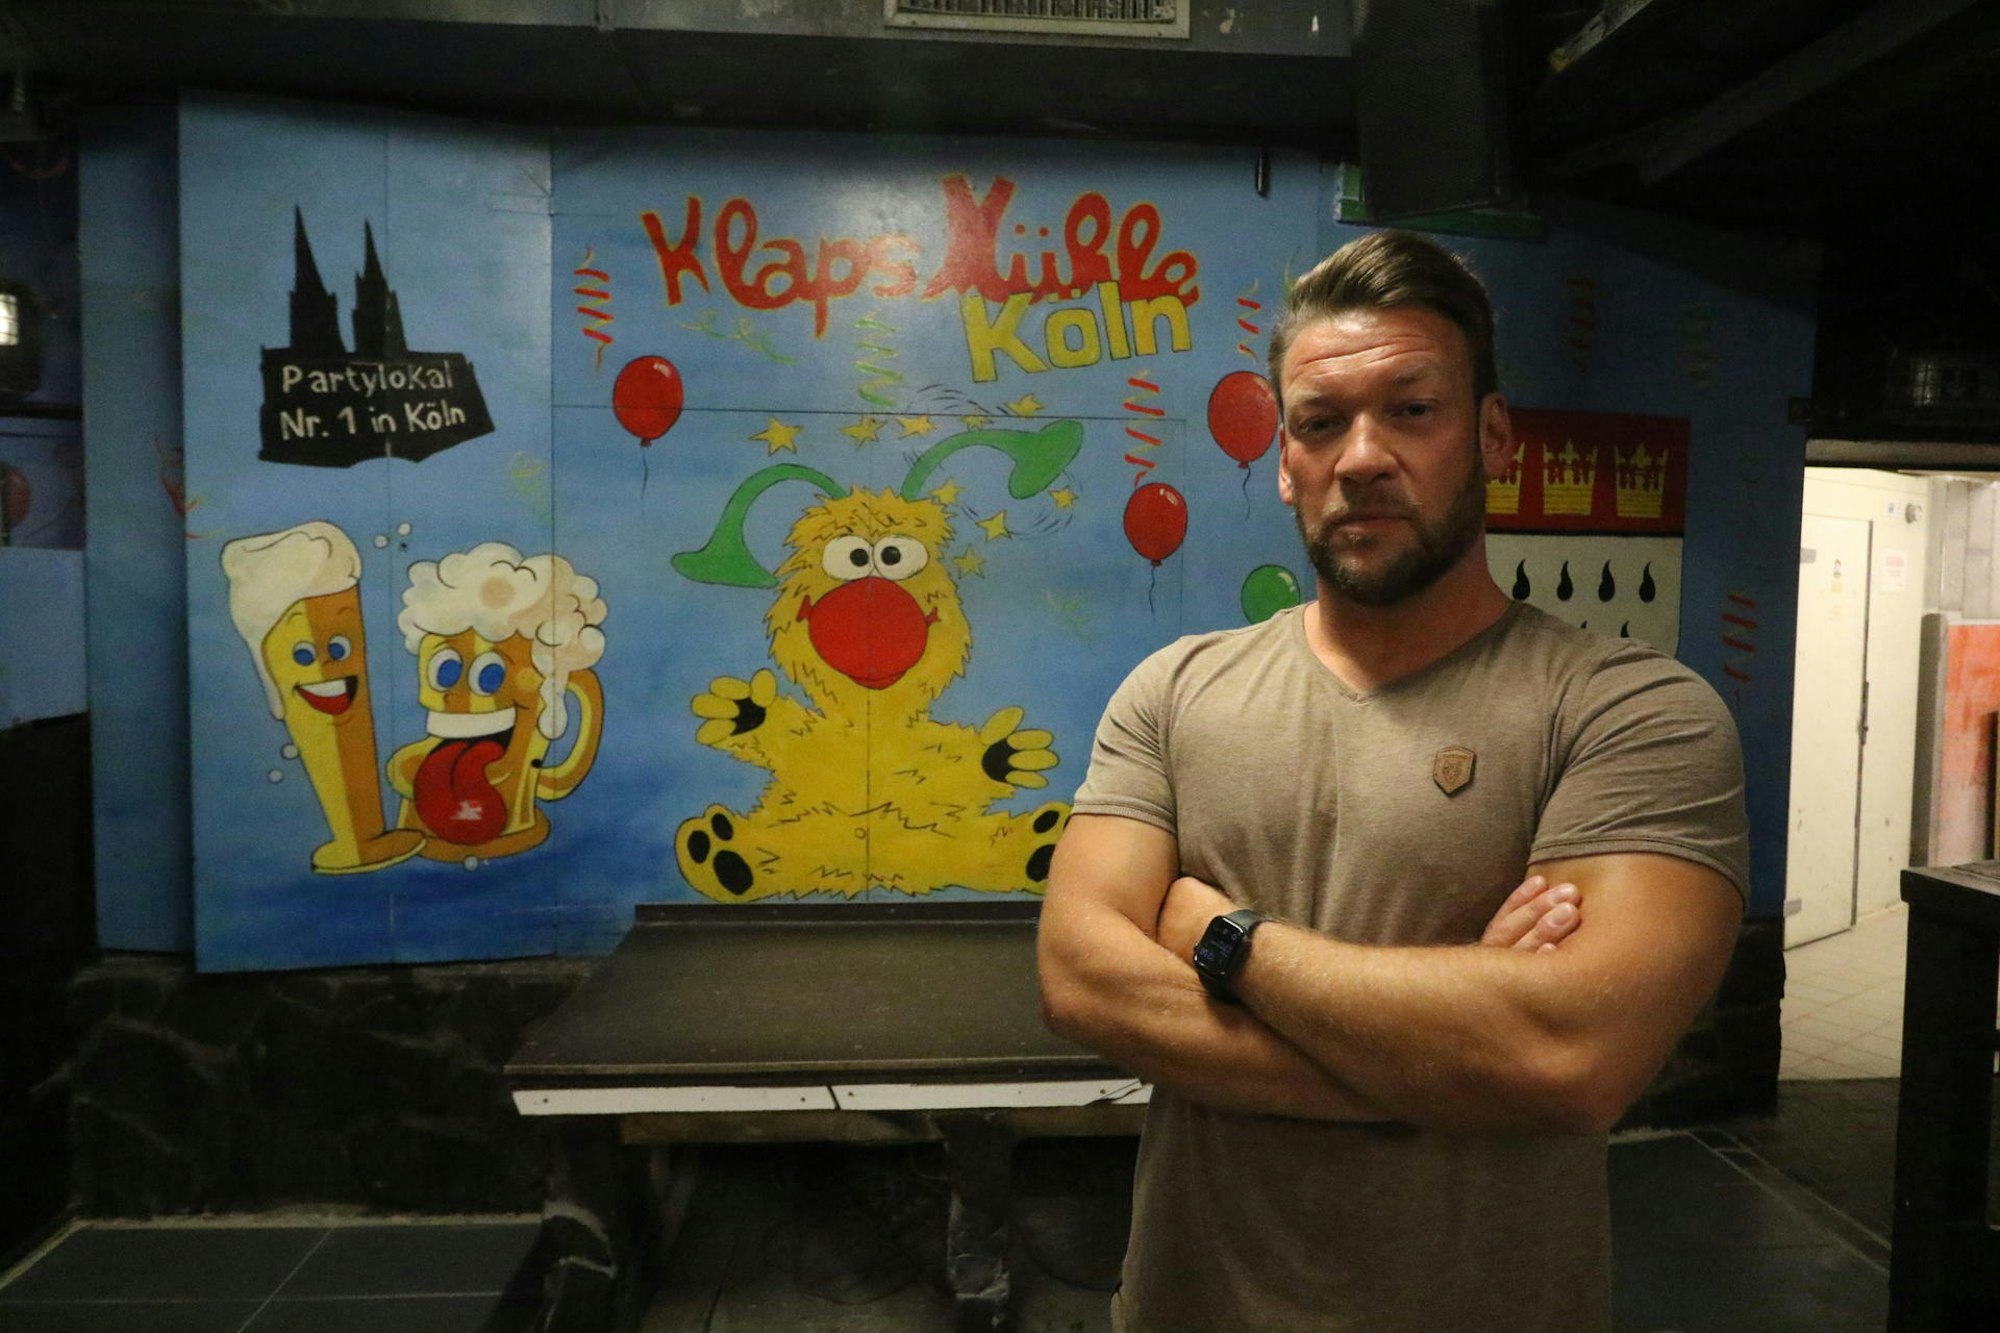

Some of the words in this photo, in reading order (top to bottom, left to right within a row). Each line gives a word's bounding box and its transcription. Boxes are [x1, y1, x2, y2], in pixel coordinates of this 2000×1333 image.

[641, 195, 920, 339] Klaps
[960, 279, 1193, 383] Köln
[279, 407, 330, 441] Nr.
[337, 405, 357, 435] 1
[368, 406, 397, 434] in
[404, 398, 467, 433] Köln
